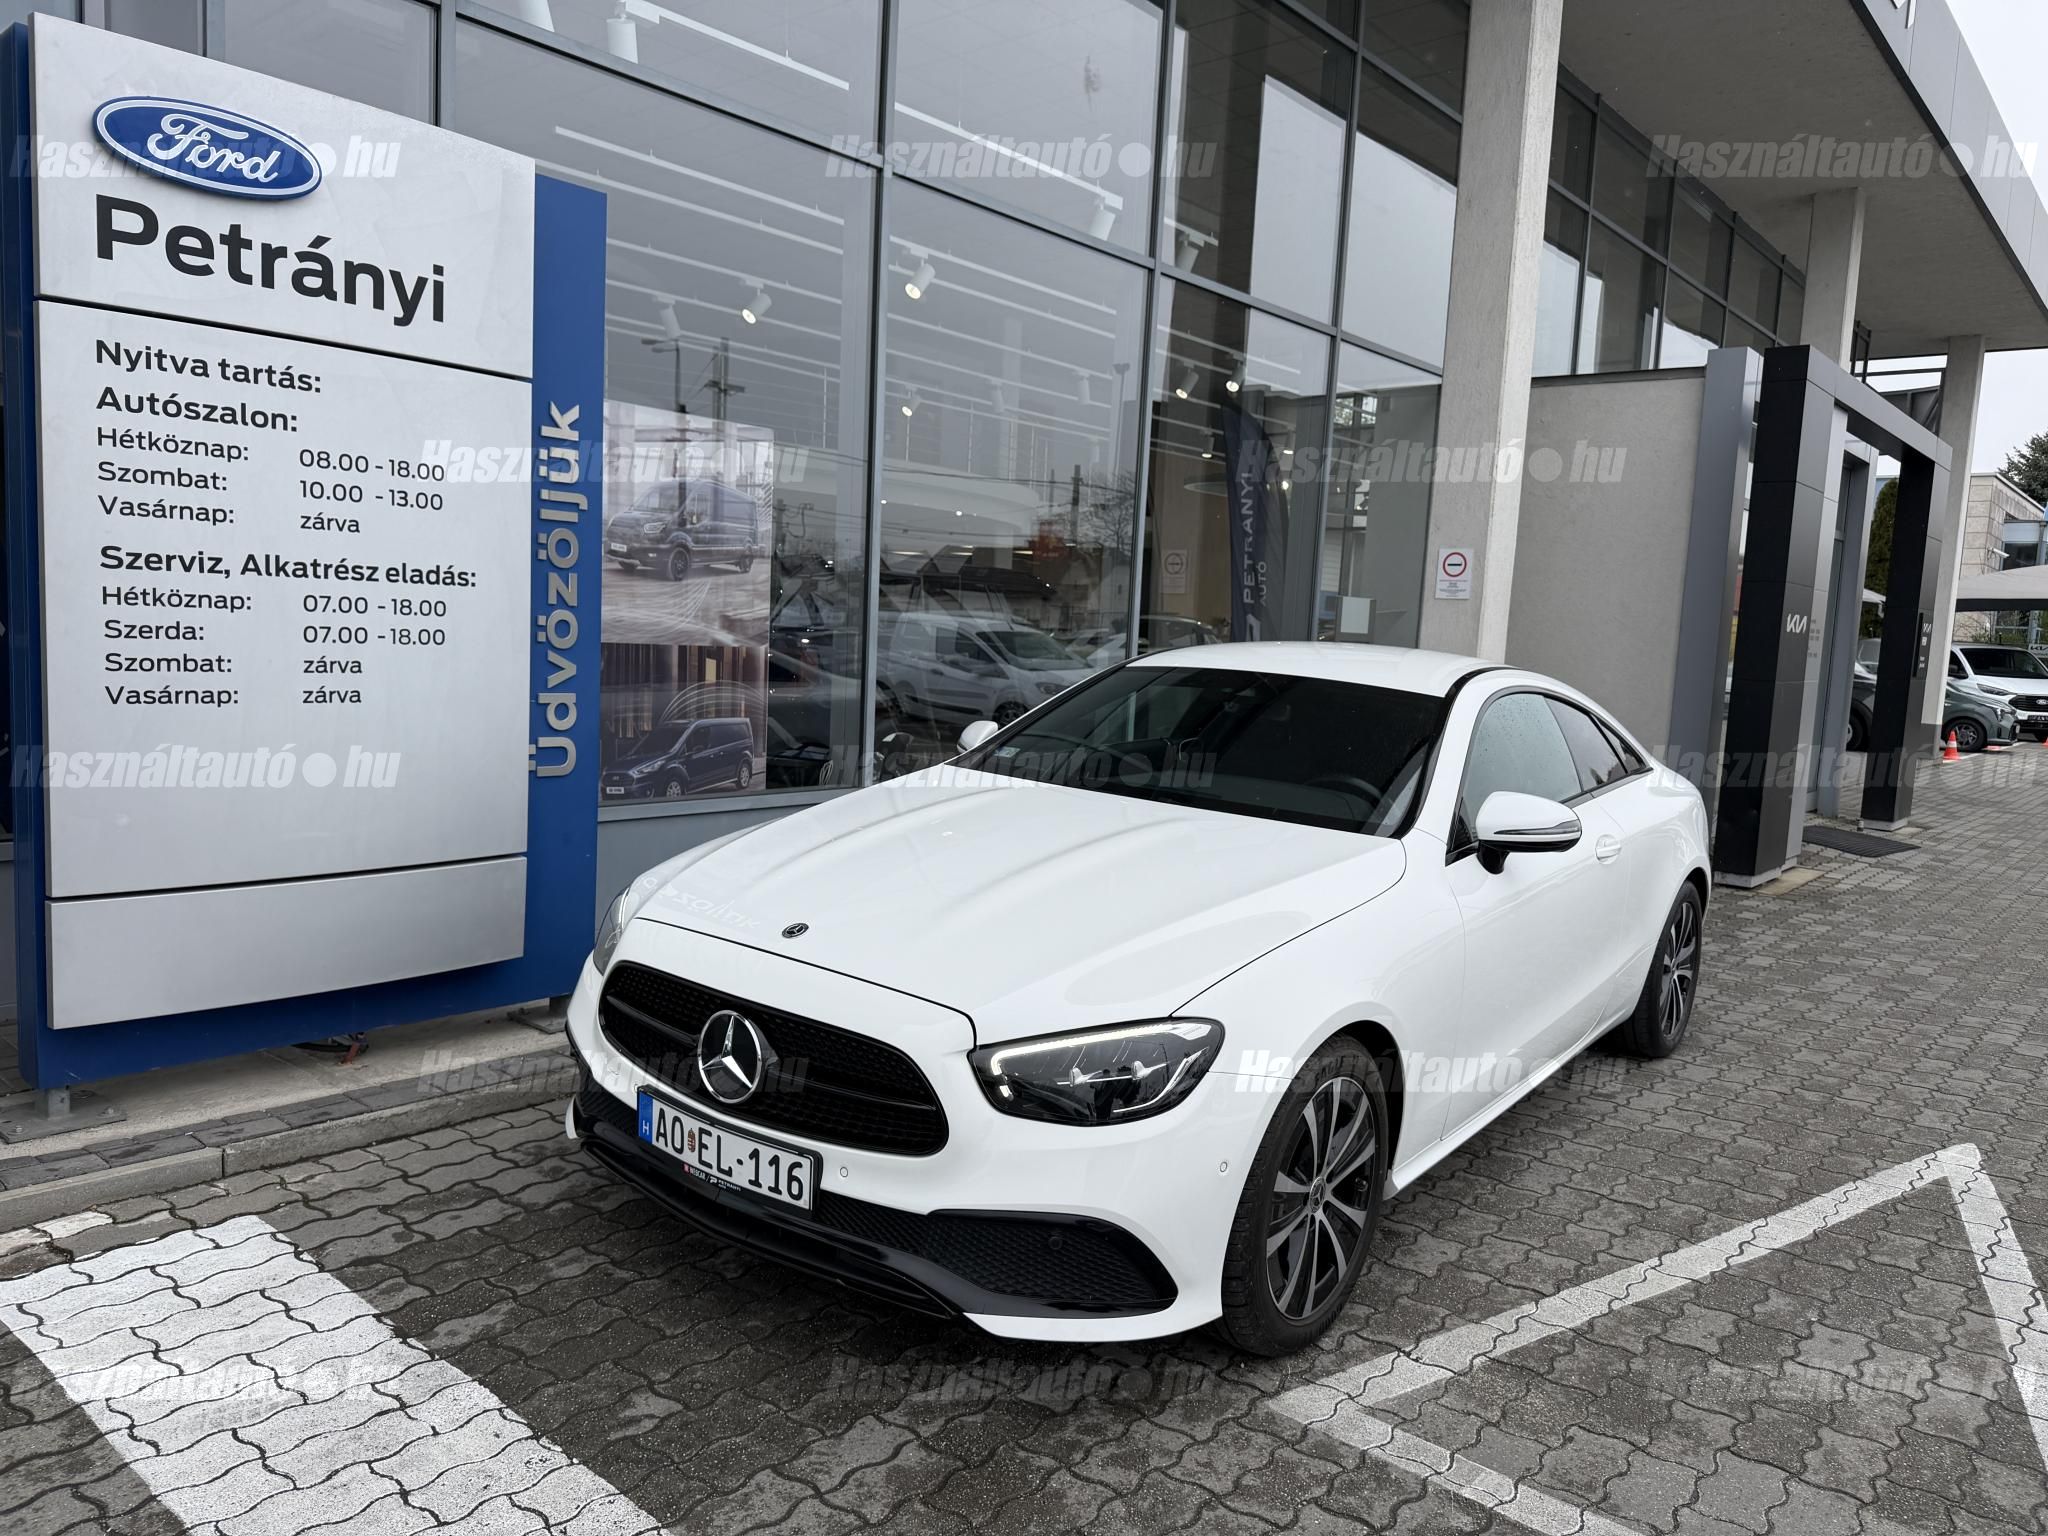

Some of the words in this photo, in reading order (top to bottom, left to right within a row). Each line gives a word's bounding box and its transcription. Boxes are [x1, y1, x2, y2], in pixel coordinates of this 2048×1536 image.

[147, 114, 281, 182] Ford
[95, 193, 444, 327] Petrányi
[96, 339, 210, 378] Nyitva
[217, 358, 321, 394] tartás:
[95, 386, 297, 433] Autószalon:
[97, 426, 249, 463] Hétköznap:
[97, 461, 227, 491] Szombat:
[299, 479, 363, 503] 10.00
[97, 494, 234, 526] Vasárnap:
[300, 511, 361, 533] zárva
[99, 545, 231, 579] Szerviz,
[240, 553, 380, 582] Alkatrész
[385, 562, 476, 588] eladás:
[1256, 561, 1268, 607] AUTÓ
[102, 585, 252, 612] Hétköznap:
[528, 401, 589, 777] Üdvözöljük
[103, 619, 204, 641] Szerda:
[1786, 613, 1808, 633] KIA
[104, 652, 232, 673] Szombat:
[303, 655, 363, 674] zárva
[104, 684, 239, 708] Vasárnap:
[302, 685, 362, 704] zárva
[642, 1119, 650, 1134] H
